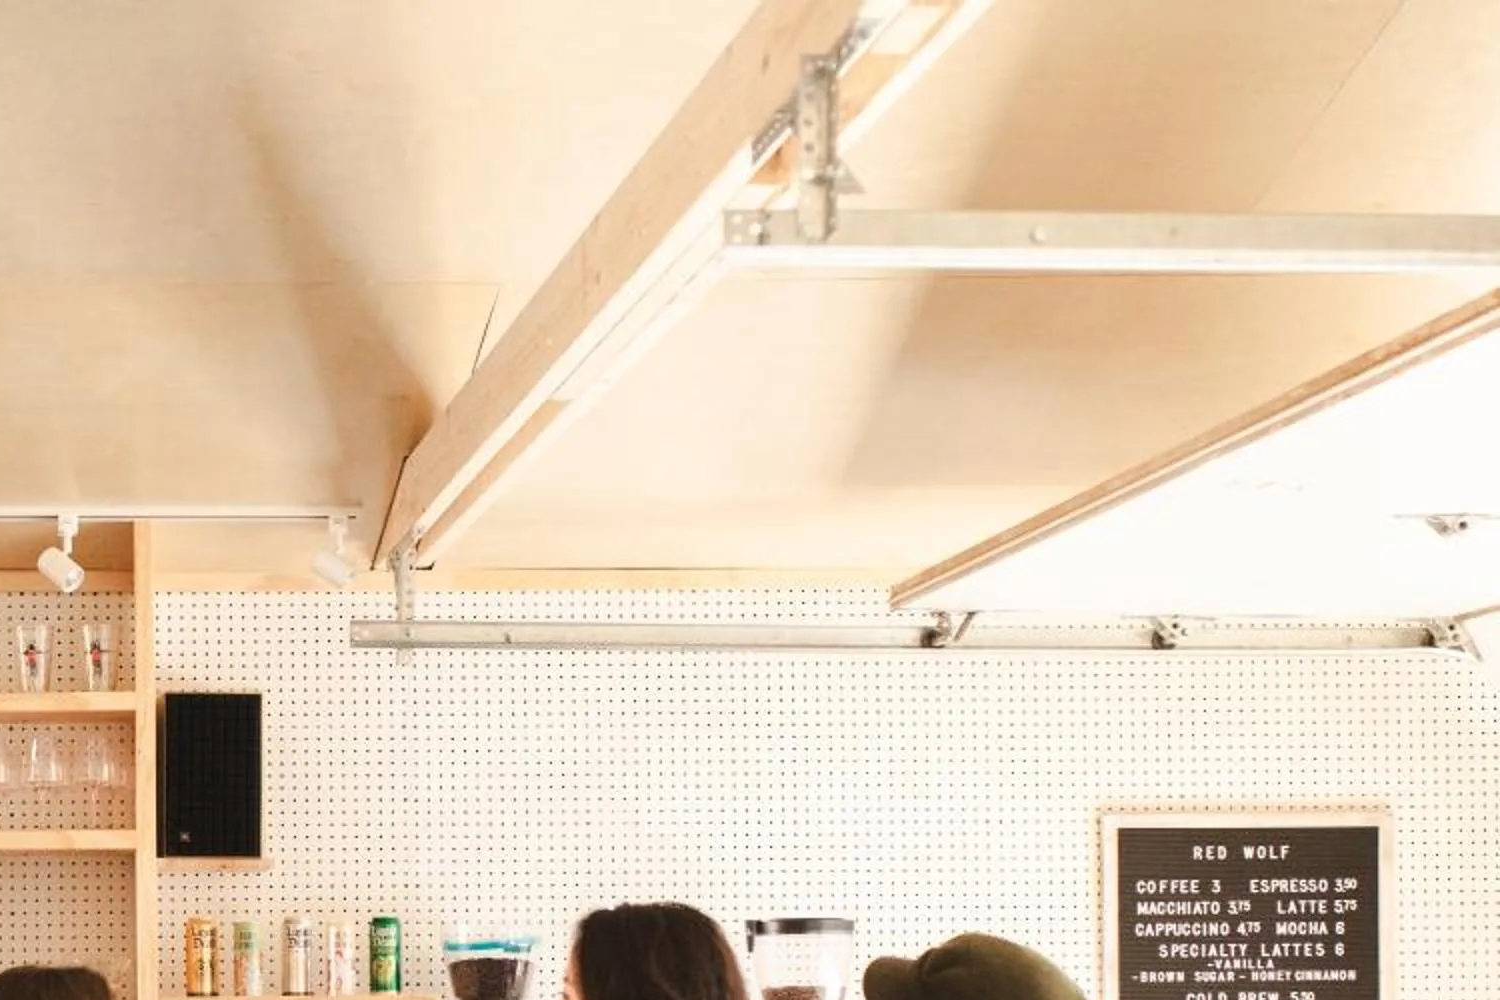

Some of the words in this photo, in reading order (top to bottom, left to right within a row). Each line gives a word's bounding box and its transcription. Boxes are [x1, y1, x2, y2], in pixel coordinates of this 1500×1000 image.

[1192, 845, 1228, 861] RED
[1242, 844, 1290, 860] WOLF
[1135, 879, 1200, 894] COFFEE
[1211, 879, 1221, 894] 3
[1249, 878, 1329, 894] ESPRESSO
[1136, 900, 1221, 916] MACCHIATO
[1276, 899, 1328, 915] LATTE
[1134, 921, 1231, 937] CAPPUCCINO
[1275, 921, 1329, 936] MOCHA
[1158, 943, 1248, 959] SPECIALTY
[1260, 942, 1326, 958] LATTES
[1334, 942, 1345, 957] 6
[1193, 970, 1235, 983] SUGAR
[1294, 969, 1357, 982] CINNAMON
